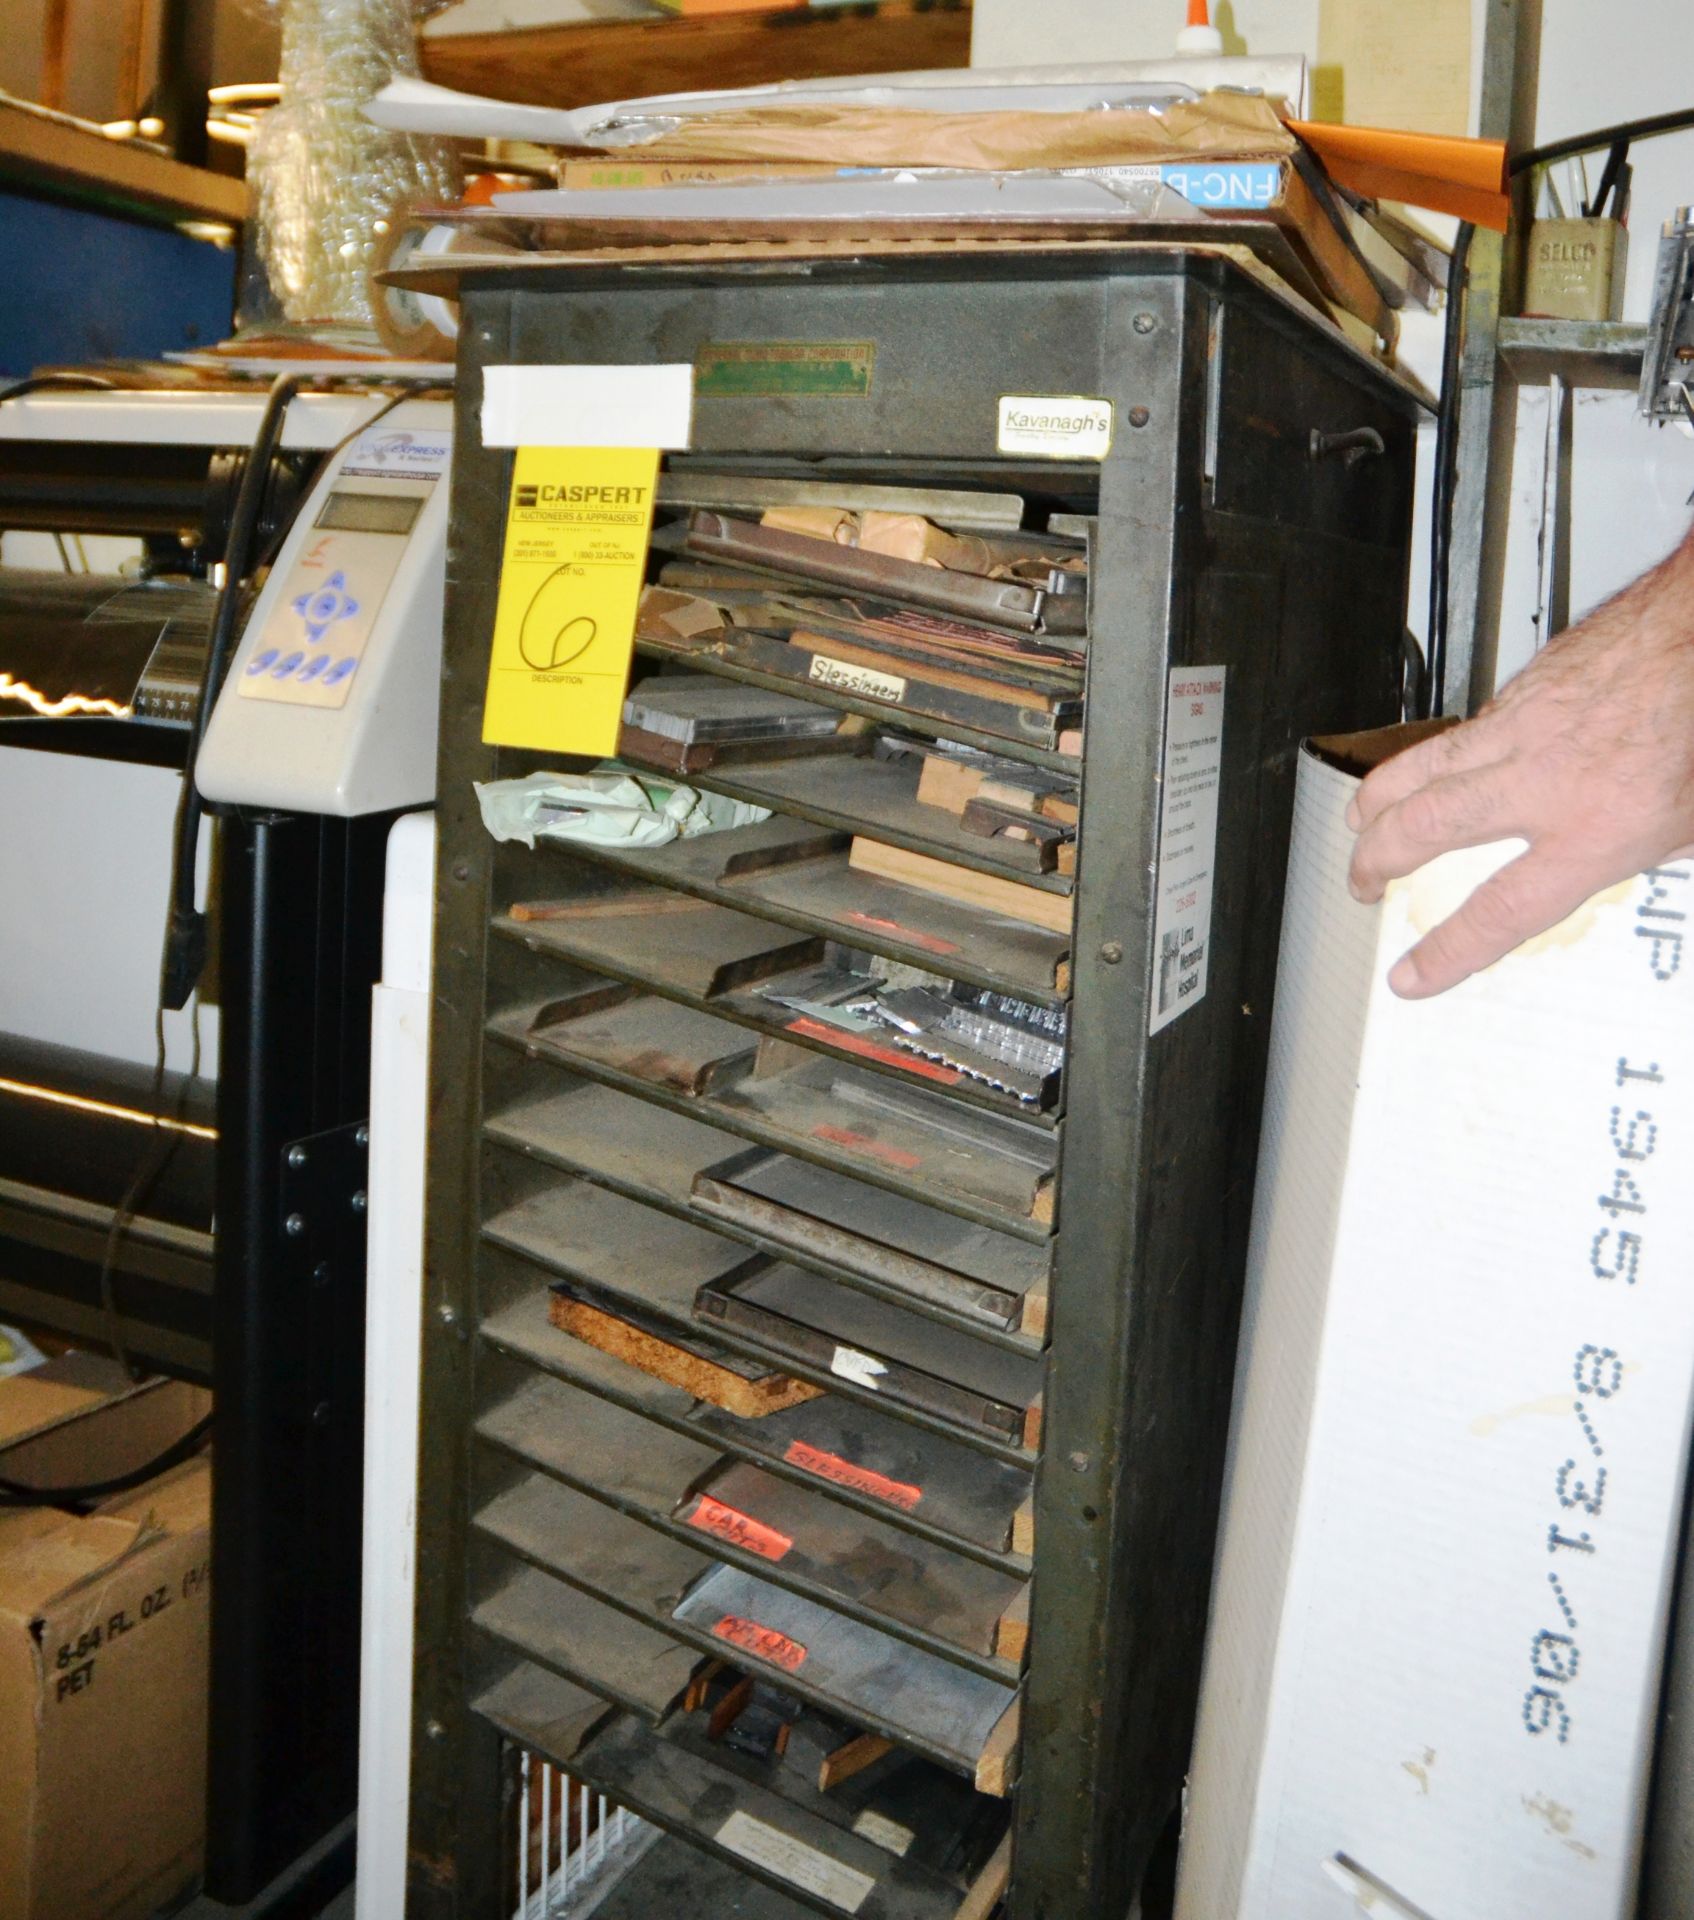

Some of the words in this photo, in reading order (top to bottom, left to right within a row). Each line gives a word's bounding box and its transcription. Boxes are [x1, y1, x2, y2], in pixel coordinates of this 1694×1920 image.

[1167, 173, 1273, 201] FNC-B
[1006, 409, 1108, 432] Kavanagh's
[540, 485, 647, 504] CASPERT
[519, 511, 575, 521] AUCTIONEERS
[575, 511, 583, 521] &
[585, 512, 639, 523] APPRAISERS
[519, 562, 597, 671] 6
[531, 674, 583, 685] DESCRIPTION
[1590, 1056, 1664, 1284] 1945
[1521, 1343, 1623, 1744] 8/31/06
[56, 1658, 95, 1703] PET
